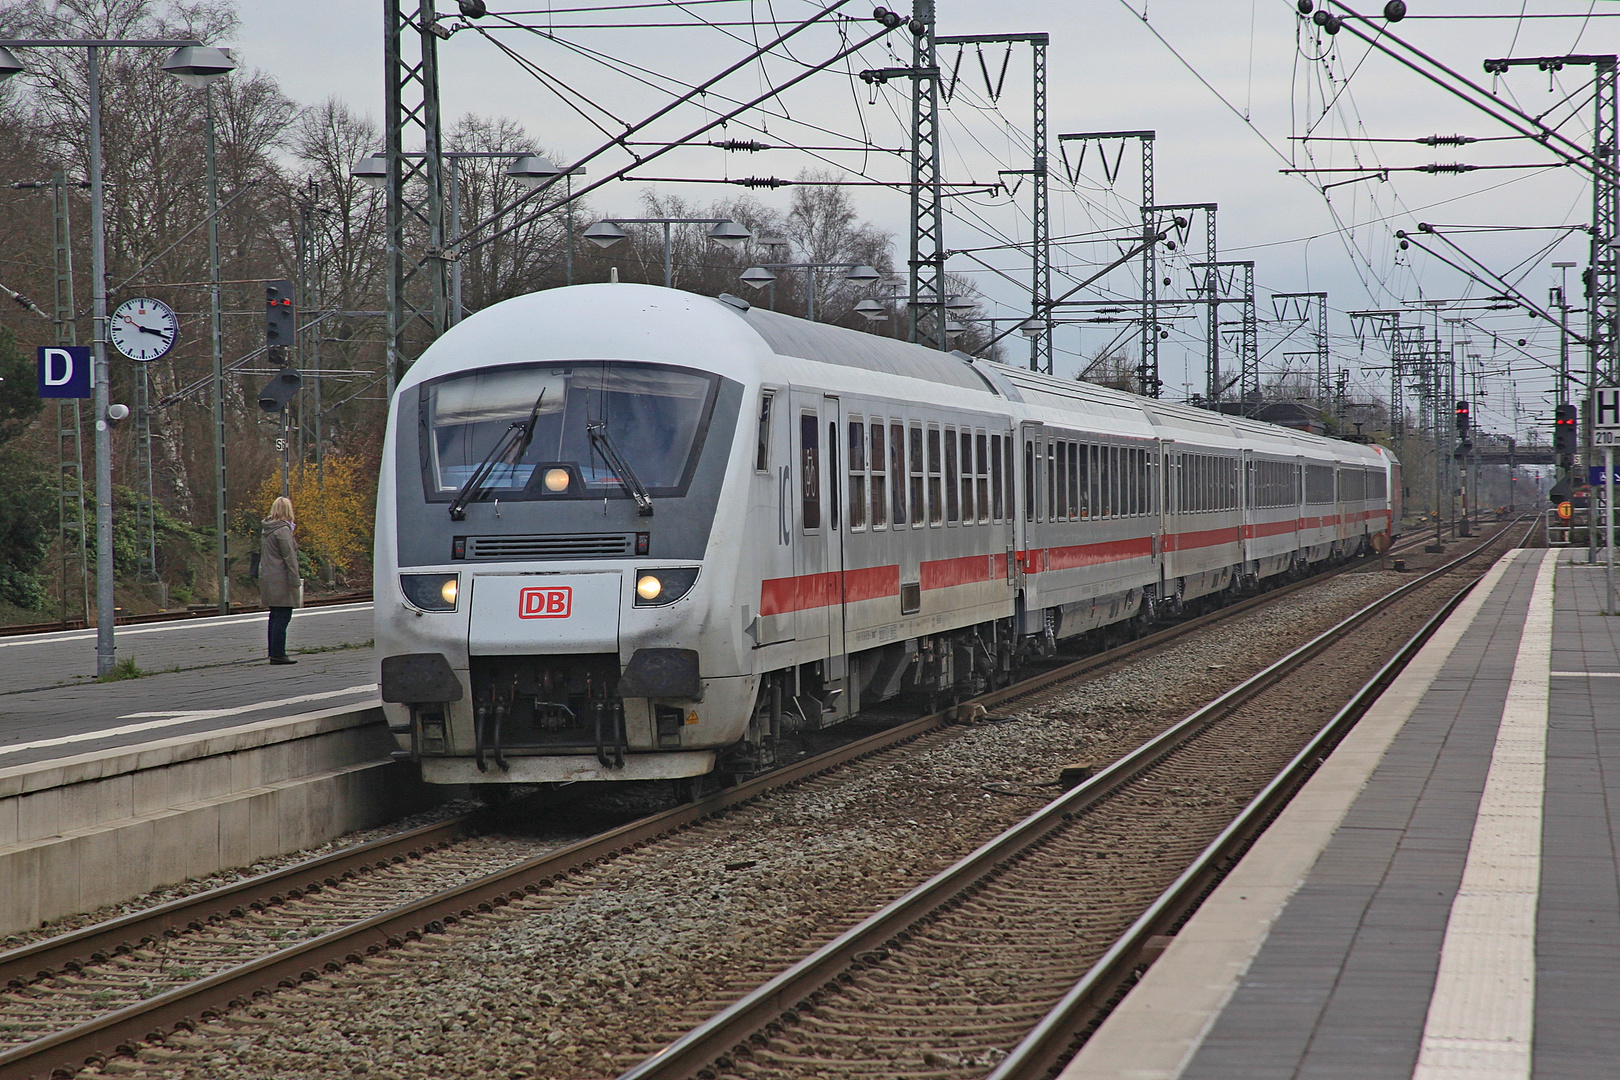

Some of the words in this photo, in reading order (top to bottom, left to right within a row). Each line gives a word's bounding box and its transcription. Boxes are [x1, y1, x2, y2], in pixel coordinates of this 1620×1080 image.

[44, 349, 73, 385] D
[1597, 391, 1619, 424] H
[1595, 432, 1613, 444] 210
[778, 465, 790, 547] IC
[525, 592, 565, 614] DB
